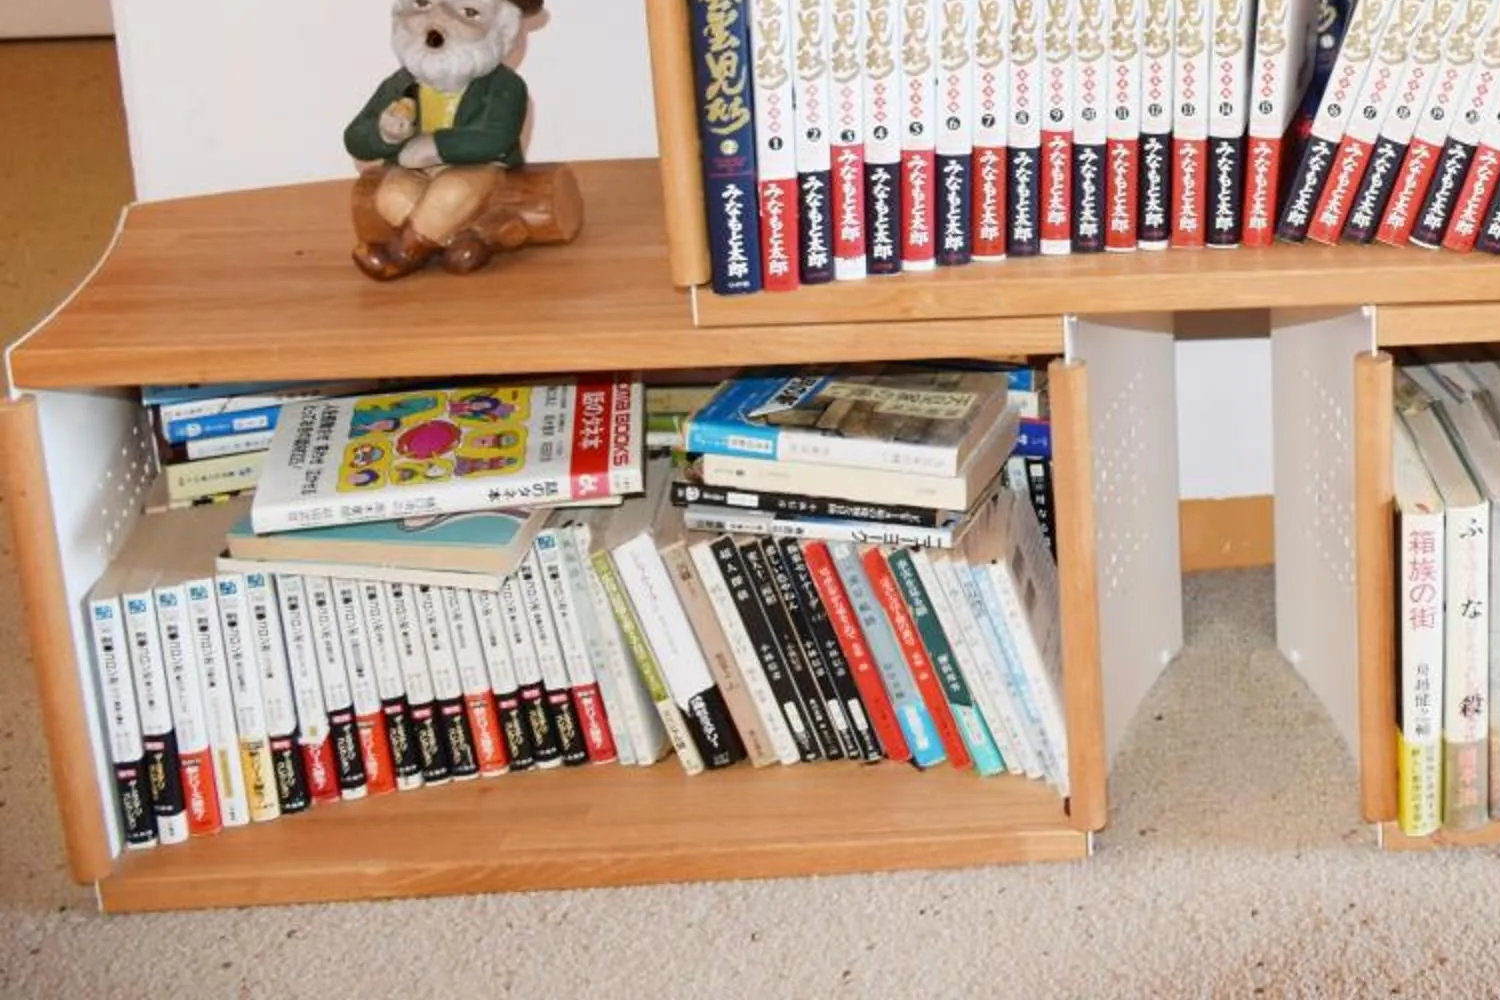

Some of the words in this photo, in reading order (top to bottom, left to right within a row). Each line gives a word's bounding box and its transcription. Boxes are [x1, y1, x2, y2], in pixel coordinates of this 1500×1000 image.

[802, 175, 827, 268] みなもと太郎
[837, 149, 861, 241] みなもと太郎
[870, 168, 893, 258] みなもと太郎
[907, 155, 929, 246] みなもと太郎
[944, 159, 965, 250] みなもと太郎
[979, 151, 1000, 241] みなもと太郎
[1012, 152, 1036, 241] みなもと太郎
[1047, 135, 1068, 225] みなもと太郎
[1078, 148, 1099, 239] みなもと太郎
[1111, 143, 1133, 233] みなもと太郎
[1143, 137, 1165, 228] みなもと太郎
[1178, 142, 1199, 232] みなもと太郎
[1215, 141, 1236, 230] みなもと太郎
[1248, 142, 1269, 230] みなもと太郎
[1290, 140, 1333, 227] みなもと太郎
[1322, 144, 1364, 227] みなもと太郎
[1352, 141, 1397, 227] みなもと太郎
[1386, 142, 1431, 227] みなもと太郎
[1425, 144, 1465, 229] みなもと太郎
[1455, 150, 1499, 236] みなもと太郎
[722, 183, 748, 278] みなもと太郎
[764, 183, 788, 277] みなもと太郎
[612, 413, 634, 466] BOOKS
[1408, 531, 1438, 631] 箱族の街
